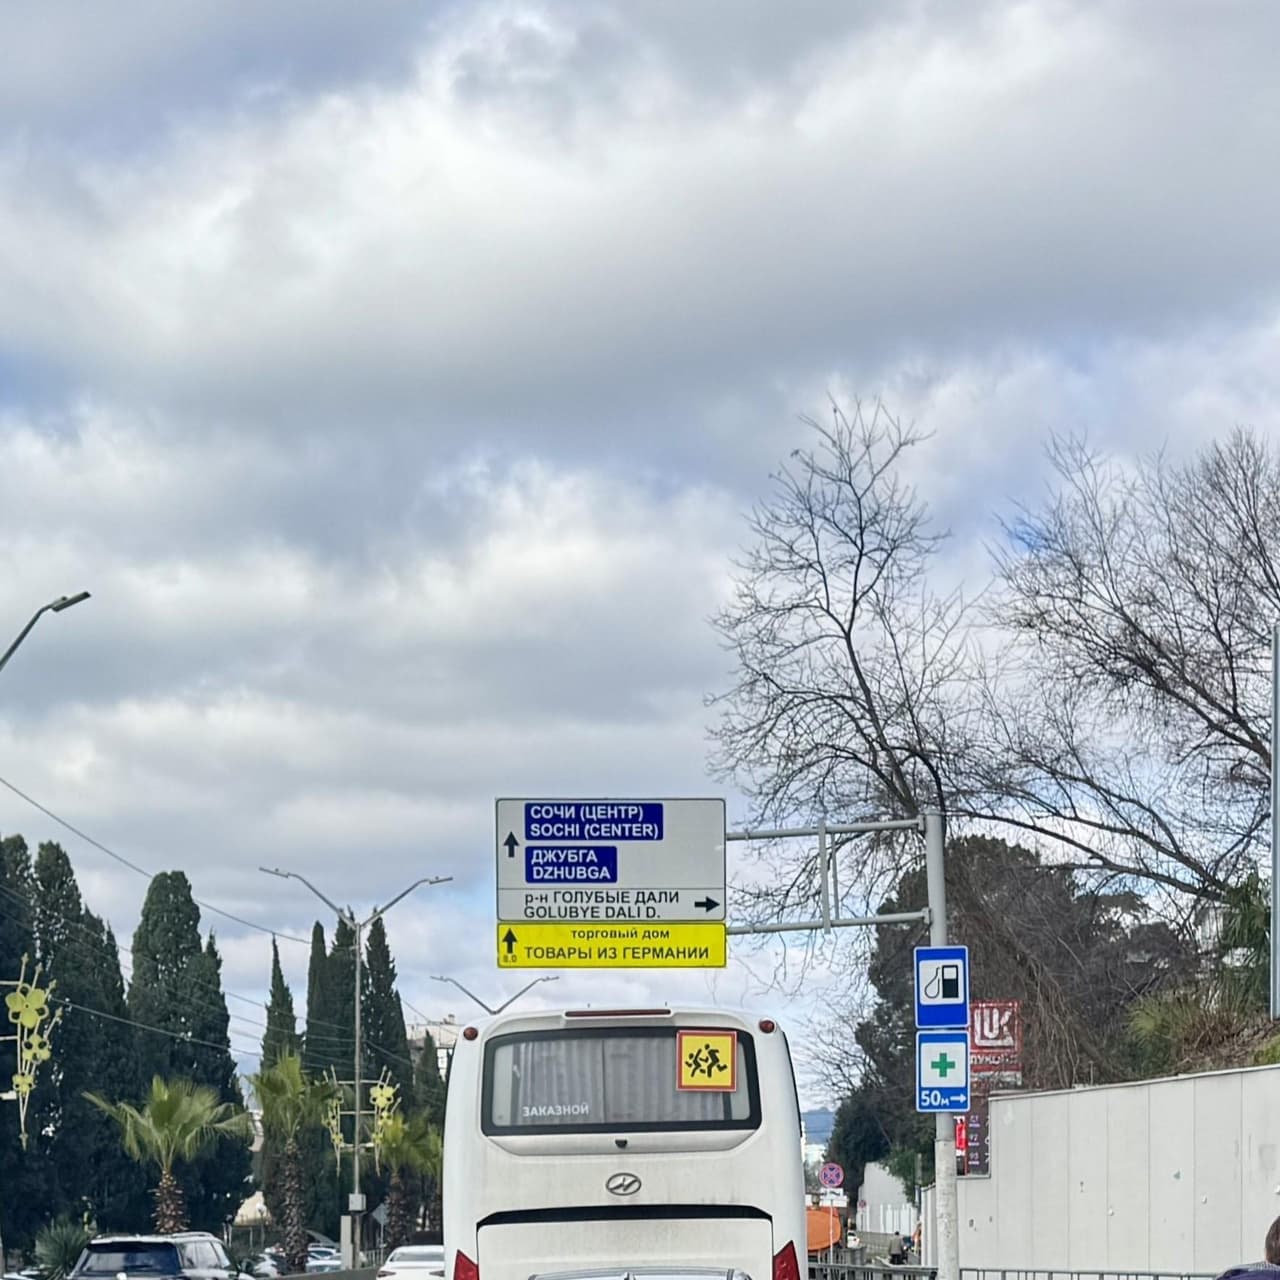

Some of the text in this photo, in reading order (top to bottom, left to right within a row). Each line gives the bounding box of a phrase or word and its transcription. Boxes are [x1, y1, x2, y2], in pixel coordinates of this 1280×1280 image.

[530, 805, 643, 821] СОЧИ (ЦЕНТР)
[530, 823, 659, 839] SOCHI (CENTER)
[531, 849, 597, 865] ДЖУБГА
[533, 866, 611, 880] DZHUBGA
[524, 891, 679, 905] р-н ГОЛУБЫЕ ДАЛИ
[524, 906, 661, 919] GOLUBYE DALI D.
[571, 928, 669, 941] торговый дом
[524, 946, 592, 960] ТОВАРЫ
[597, 946, 617, 959] ИЗ
[623, 946, 709, 960] ГЕРМАНИИ
[522, 1104, 589, 1118] ЗАКАЗНОЙ
